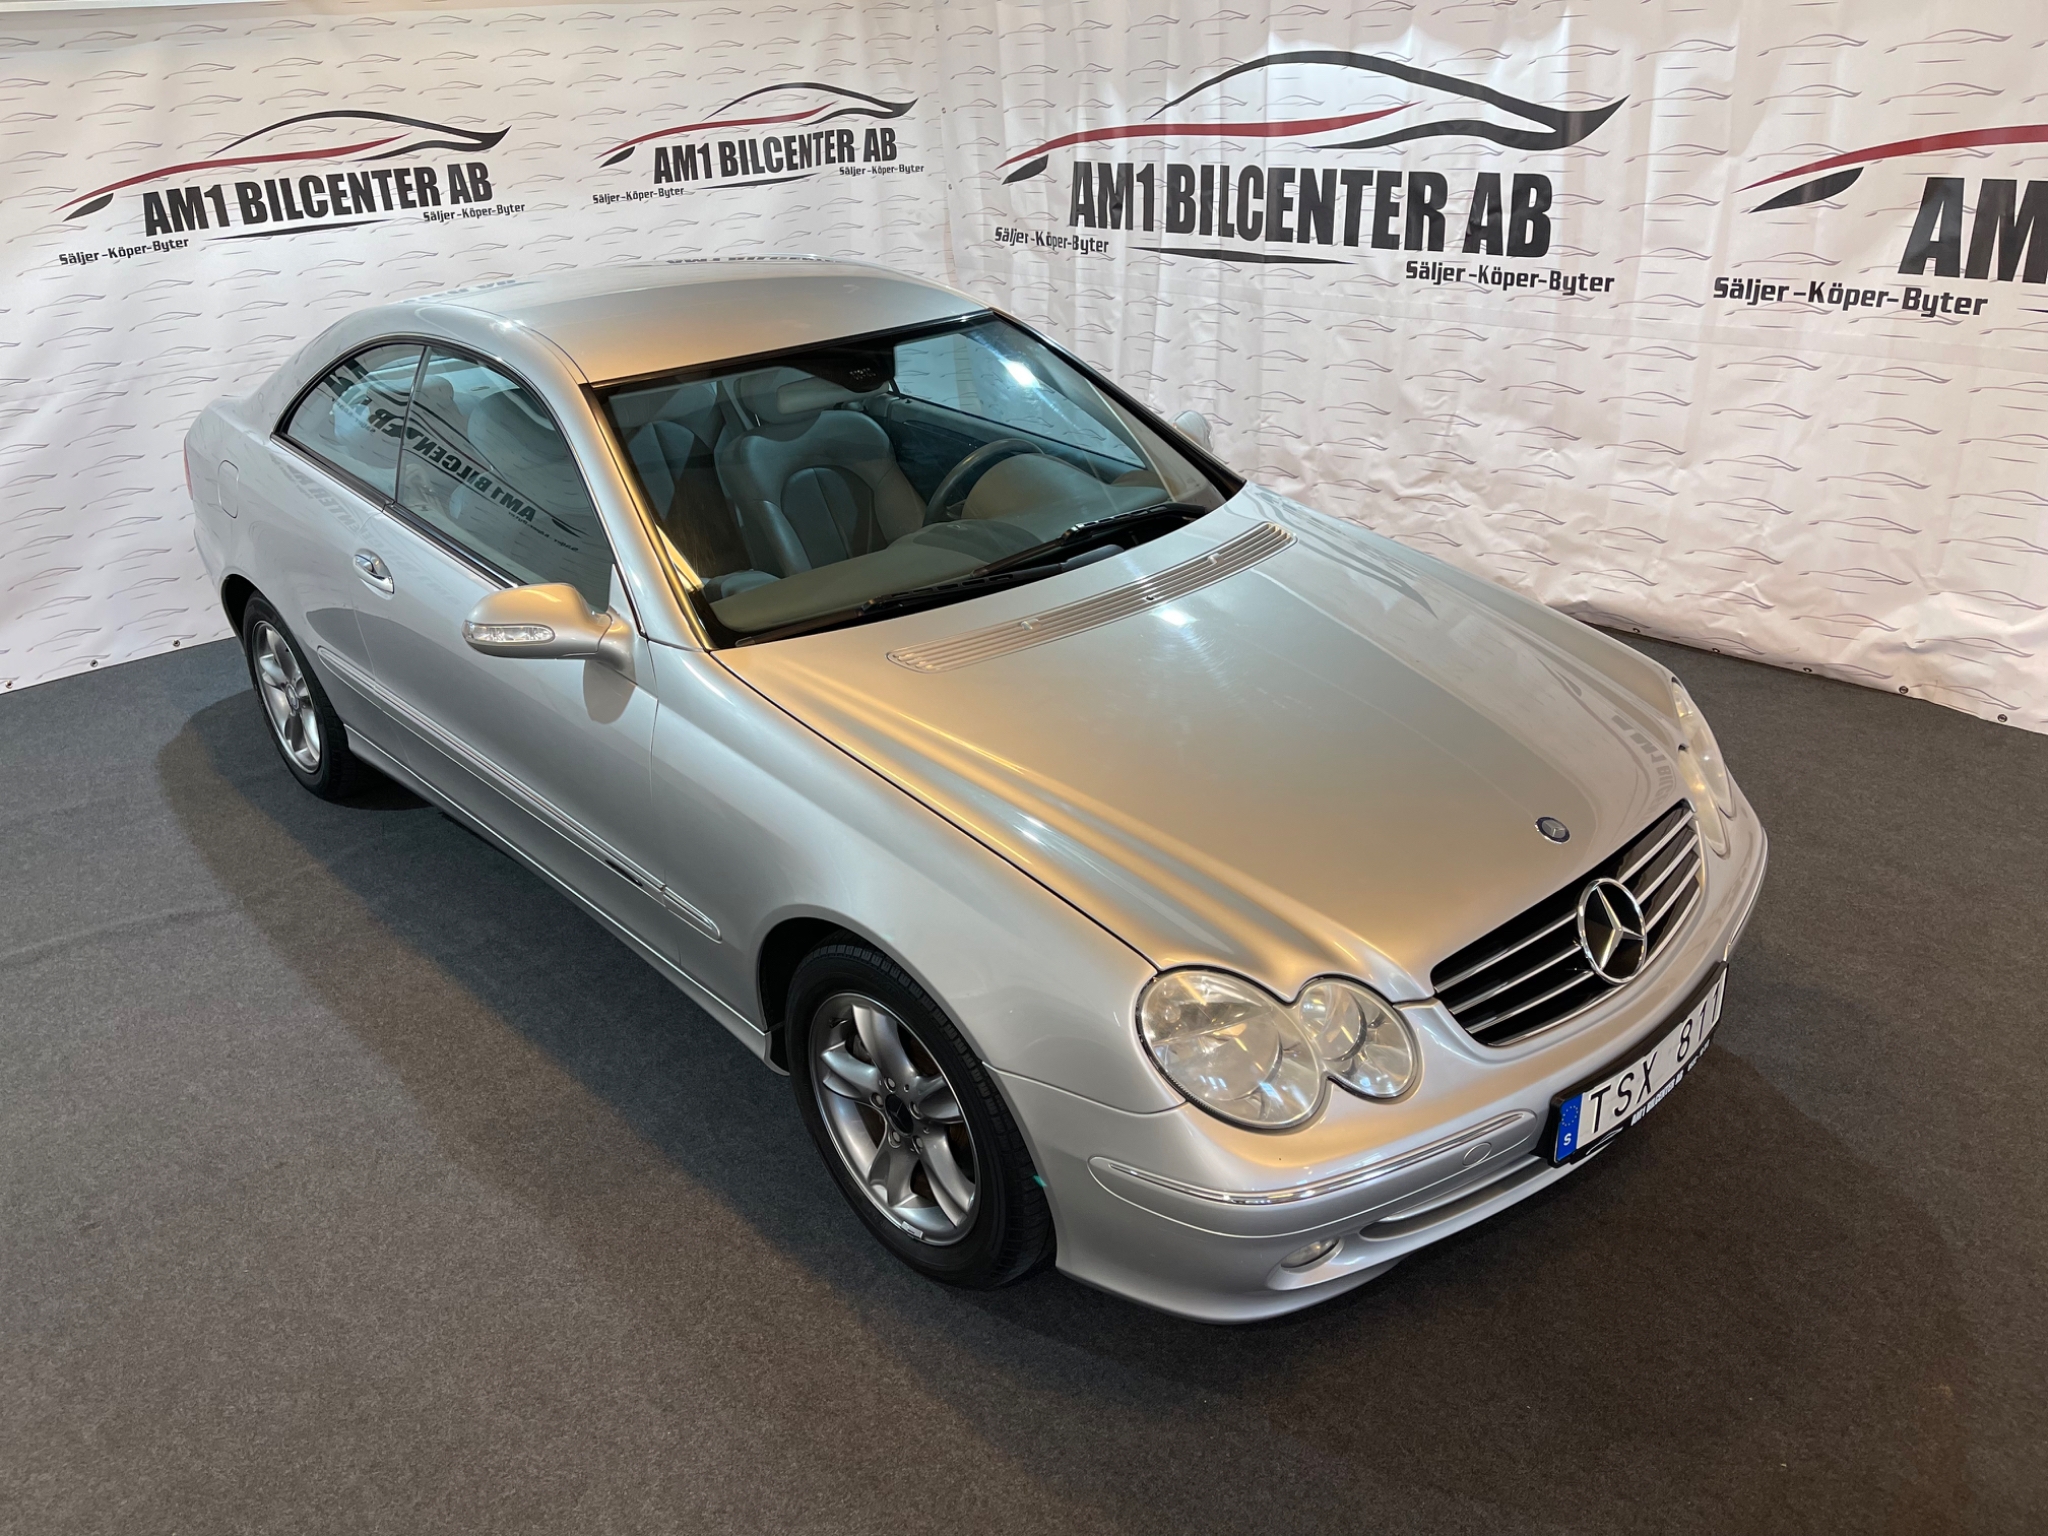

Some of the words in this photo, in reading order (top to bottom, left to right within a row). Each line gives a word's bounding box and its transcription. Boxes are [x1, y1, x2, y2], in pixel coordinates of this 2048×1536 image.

[654, 143, 713, 185] AM1
[718, 128, 855, 178] BILCENTER
[863, 127, 898, 162] AB
[143, 184, 230, 237] AM1
[235, 166, 442, 225] BILCENTER
[448, 162, 494, 205] AB
[1069, 161, 1155, 232] AM1
[1165, 163, 1448, 252] BILCENTER
[1461, 172, 1553, 258] AB
[1589, 1050, 1658, 1133] TSX
[1676, 982, 1721, 1063] 811
[1563, 1132, 1572, 1146] S
